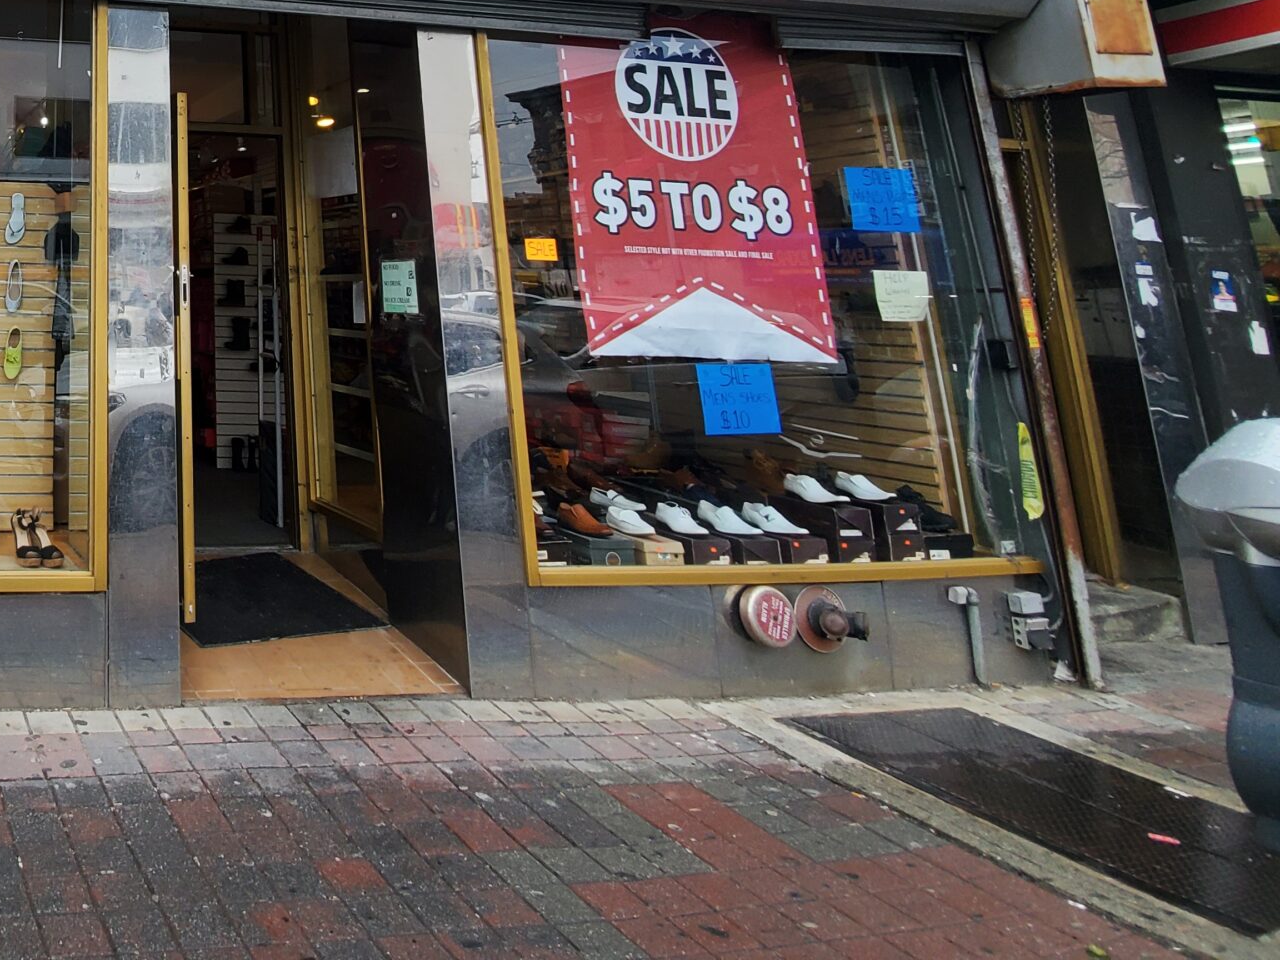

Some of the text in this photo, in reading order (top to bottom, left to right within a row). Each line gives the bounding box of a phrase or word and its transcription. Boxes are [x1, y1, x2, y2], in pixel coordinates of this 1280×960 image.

[624, 62, 732, 121] SALE
[592, 170, 794, 242] $5 TO $8
[528, 241, 555, 257] SALE
[725, 250, 737, 258] SALE
[761, 252, 774, 260] SALE
[720, 365, 752, 387] SALE
[720, 409, 752, 430] $10
[761, 600, 769, 623] ALARM
